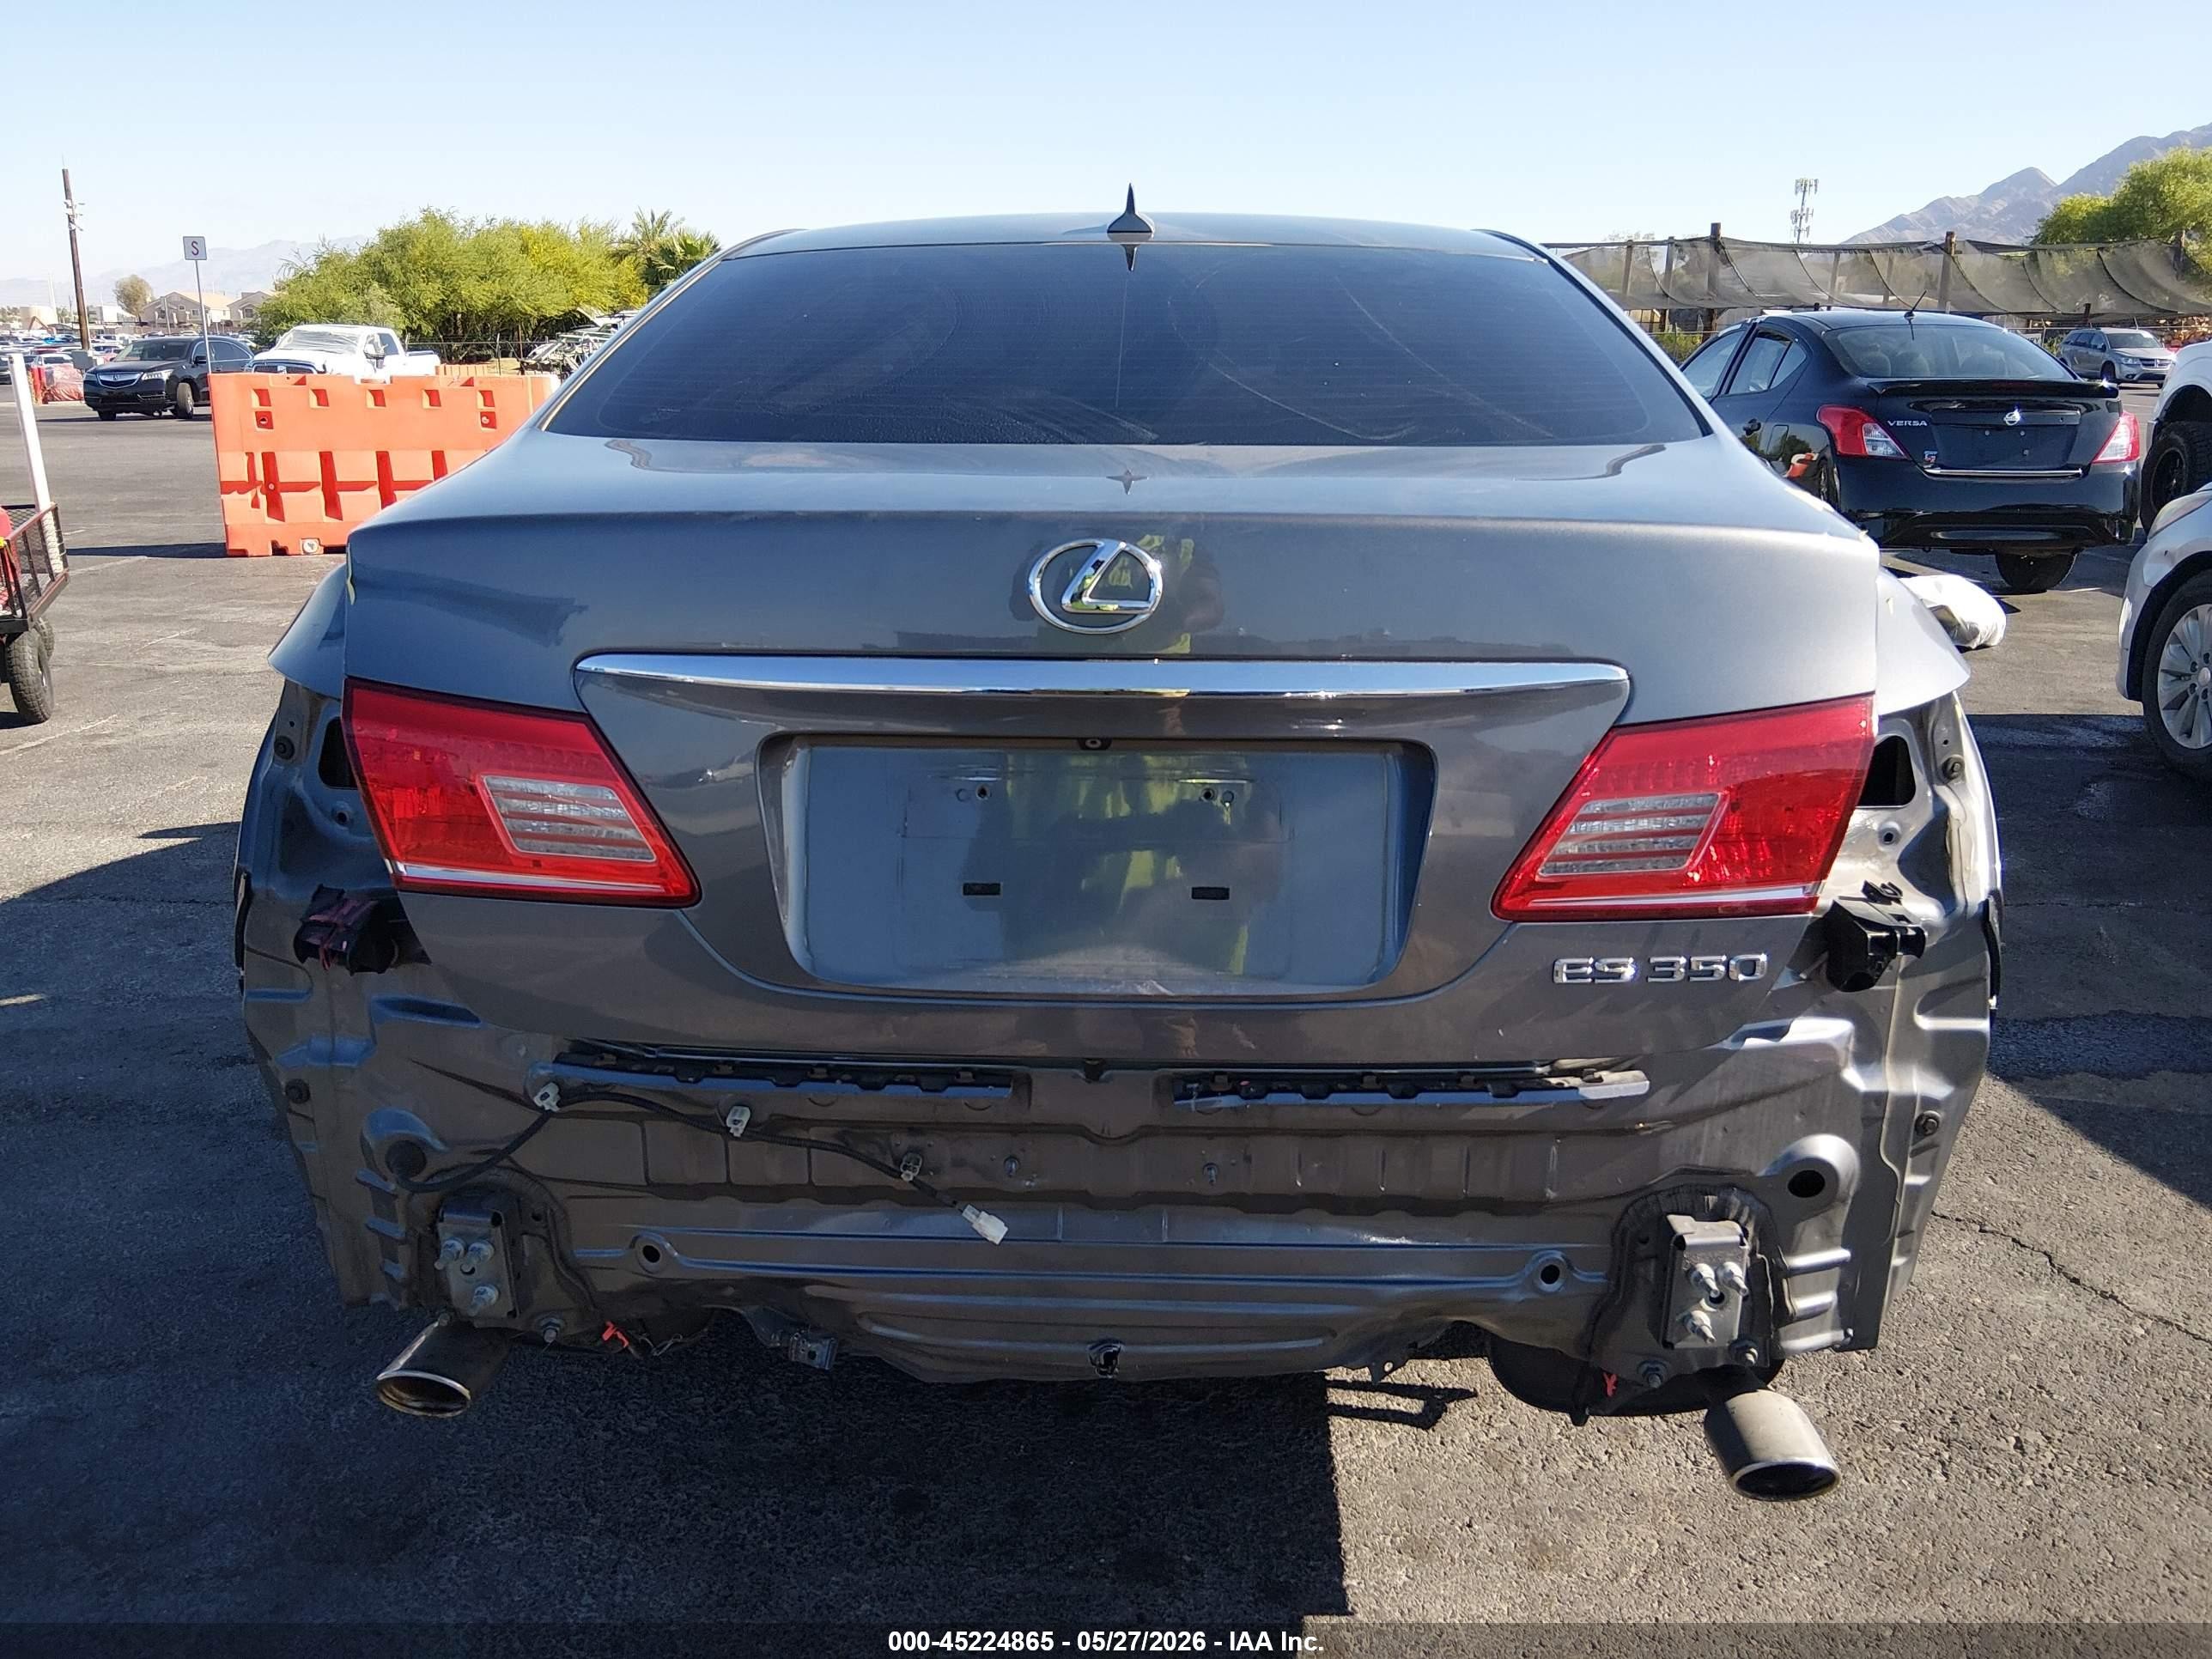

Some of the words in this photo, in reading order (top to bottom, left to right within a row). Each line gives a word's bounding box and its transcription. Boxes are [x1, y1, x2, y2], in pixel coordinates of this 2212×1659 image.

[191, 240, 199, 256] S
[1553, 956, 1637, 984] ES
[1646, 953, 1769, 983] 350
